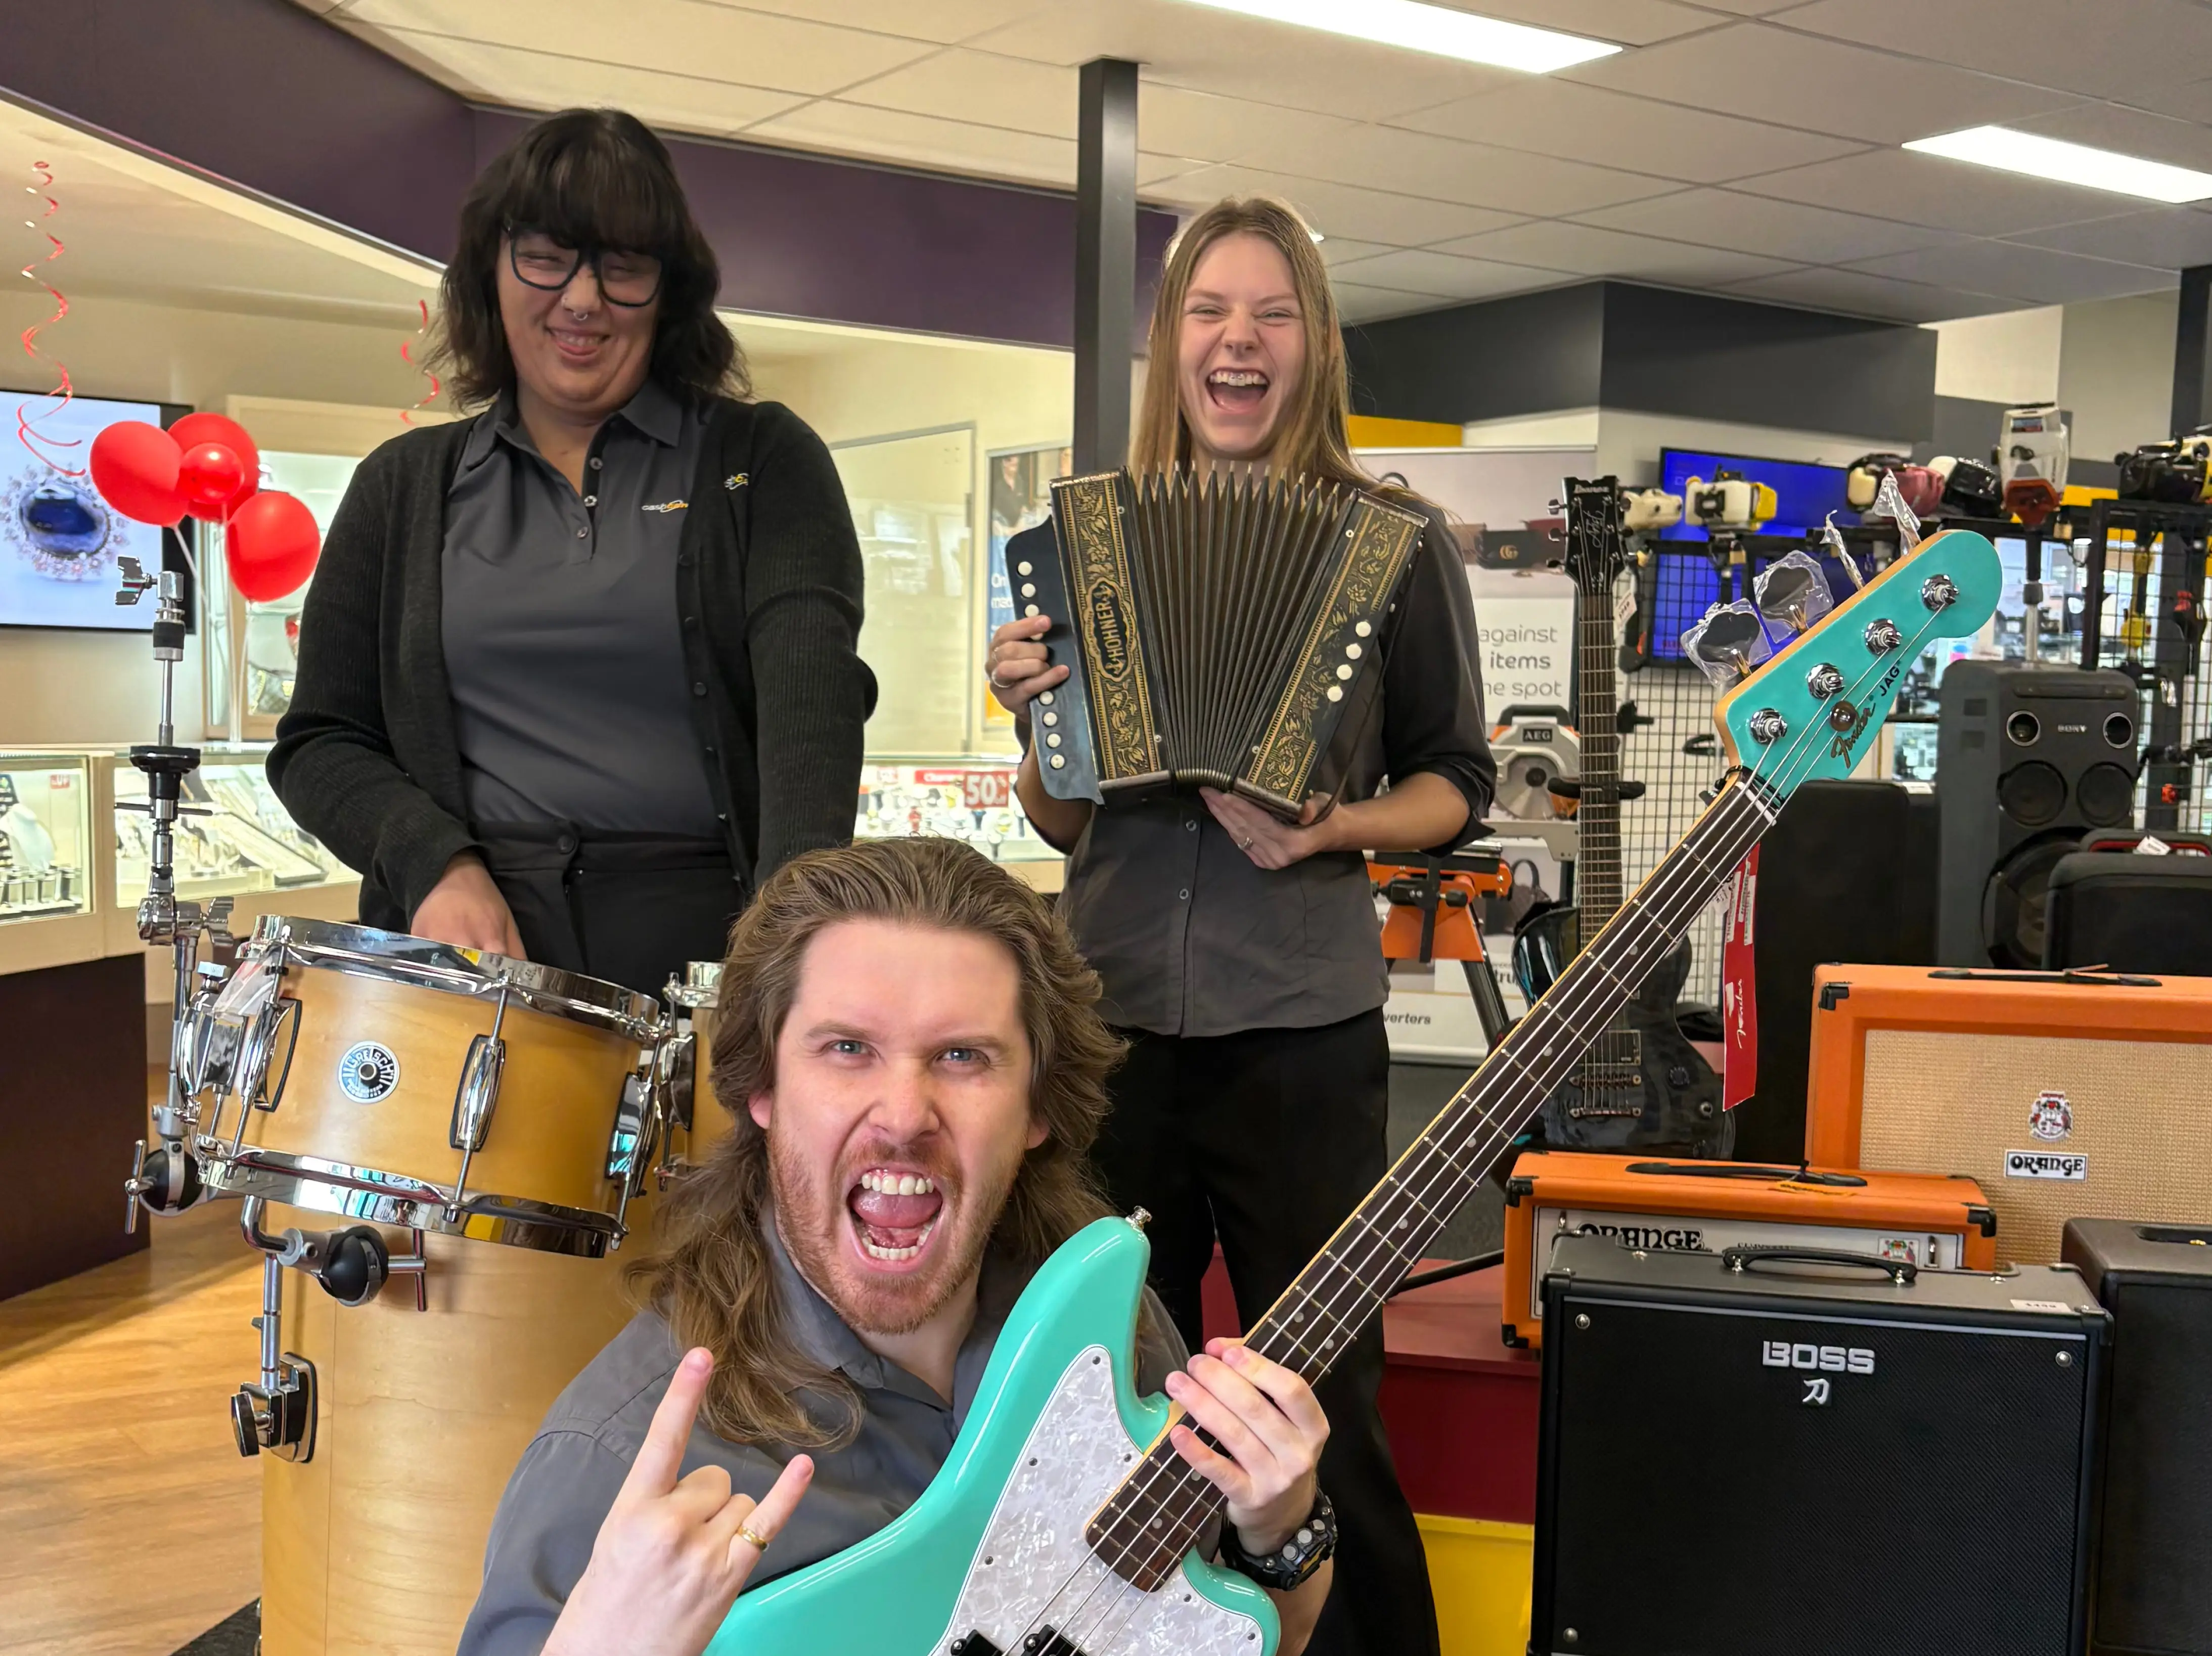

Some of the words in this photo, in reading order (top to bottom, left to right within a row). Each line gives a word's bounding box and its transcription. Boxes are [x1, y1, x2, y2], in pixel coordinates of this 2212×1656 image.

[1096, 601, 1124, 658] HOHNER
[1478, 624, 1558, 647] against
[1491, 650, 1551, 670] items
[1512, 680, 1562, 700] spot
[1879, 665, 1900, 697] JAG
[1524, 731, 1550, 740] AEG
[345, 1046, 394, 1074] GRETSCH
[2010, 1155, 2084, 1177] ORANGE
[1763, 1340, 1875, 1375] BOSS
[1802, 1378, 1830, 1405] 刀
